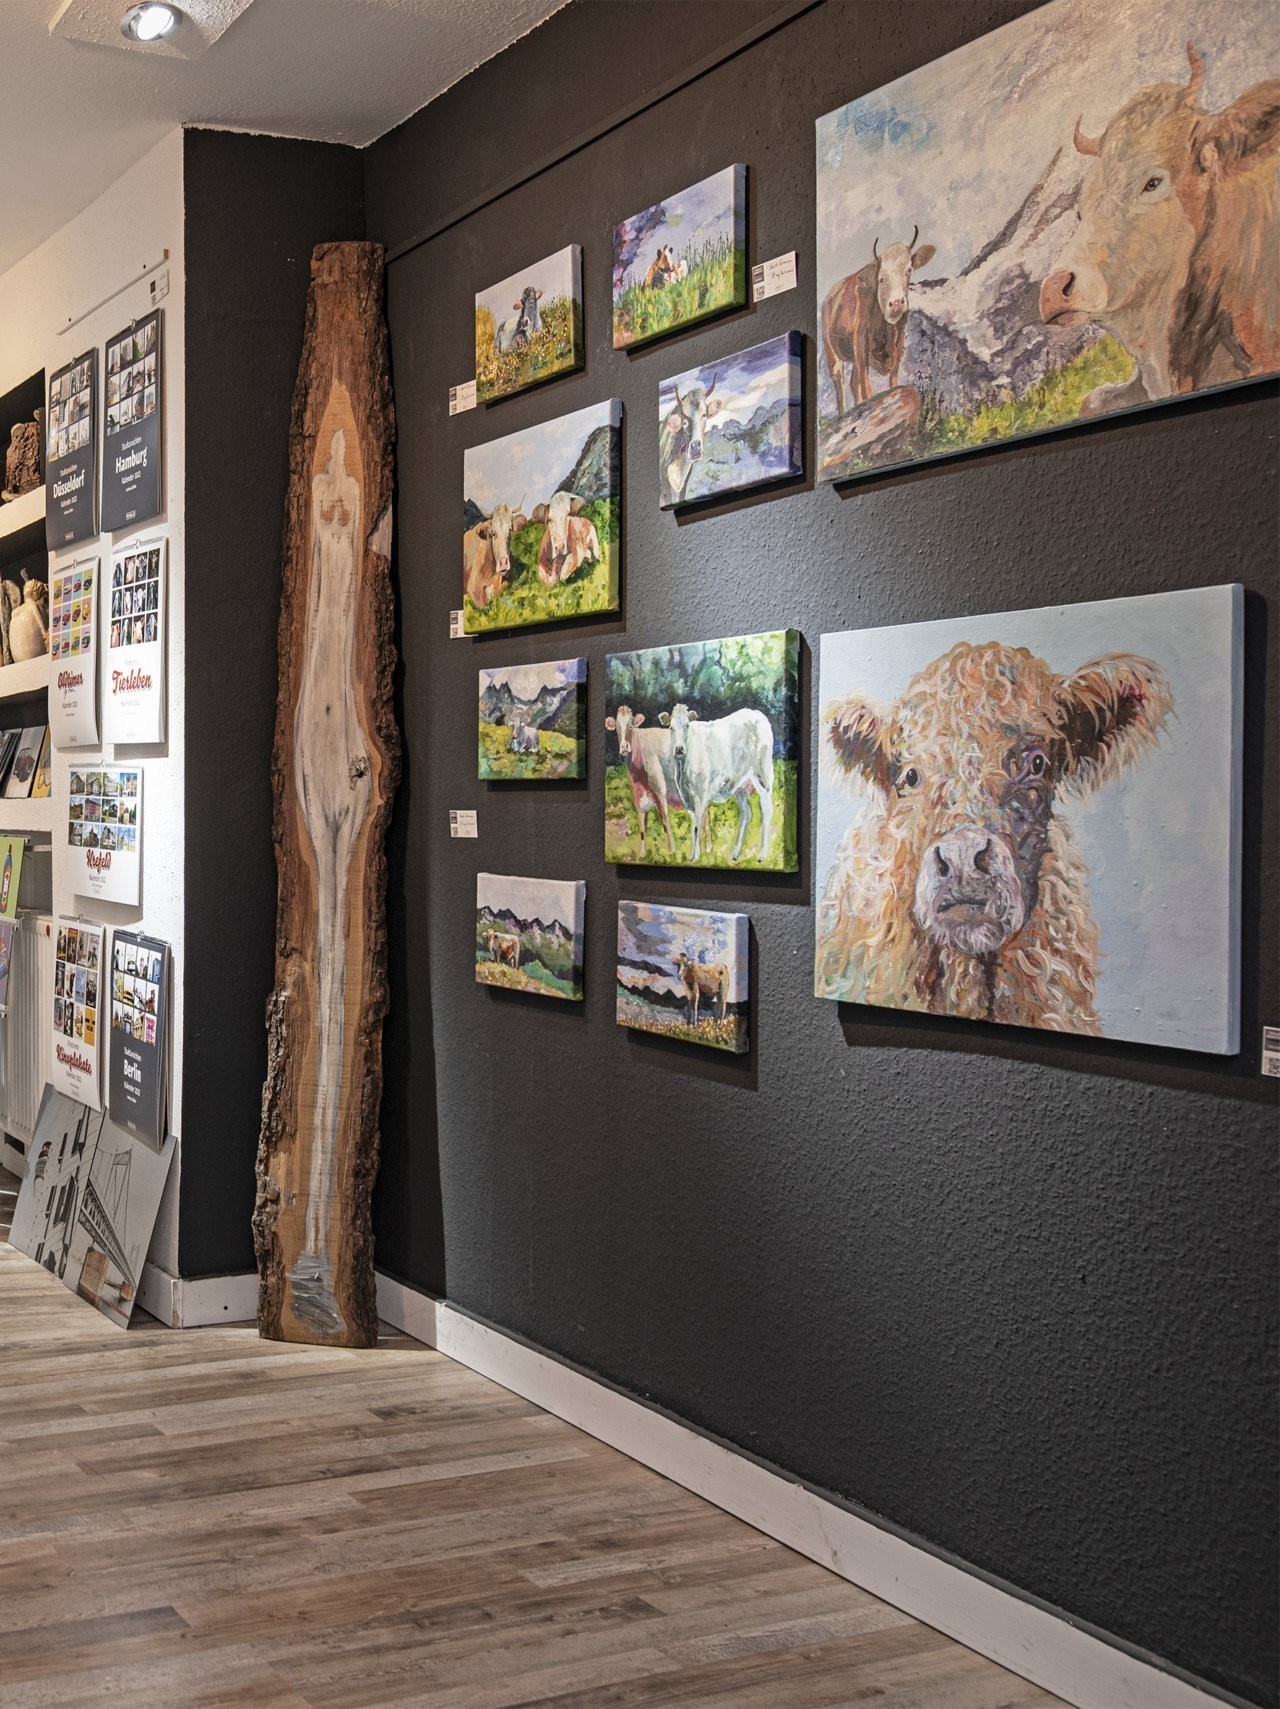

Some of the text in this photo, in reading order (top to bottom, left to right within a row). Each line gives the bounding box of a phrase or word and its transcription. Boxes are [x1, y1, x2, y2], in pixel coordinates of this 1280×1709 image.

[115, 446, 148, 474] Hamburg
[53, 469, 85, 499] Düsseldorf
[112, 667, 152, 695] Tierleben
[86, 849, 112, 875] Krefeld
[56, 1044, 92, 1075] Kinoplakate
[123, 1058, 142, 1083] Berlin
